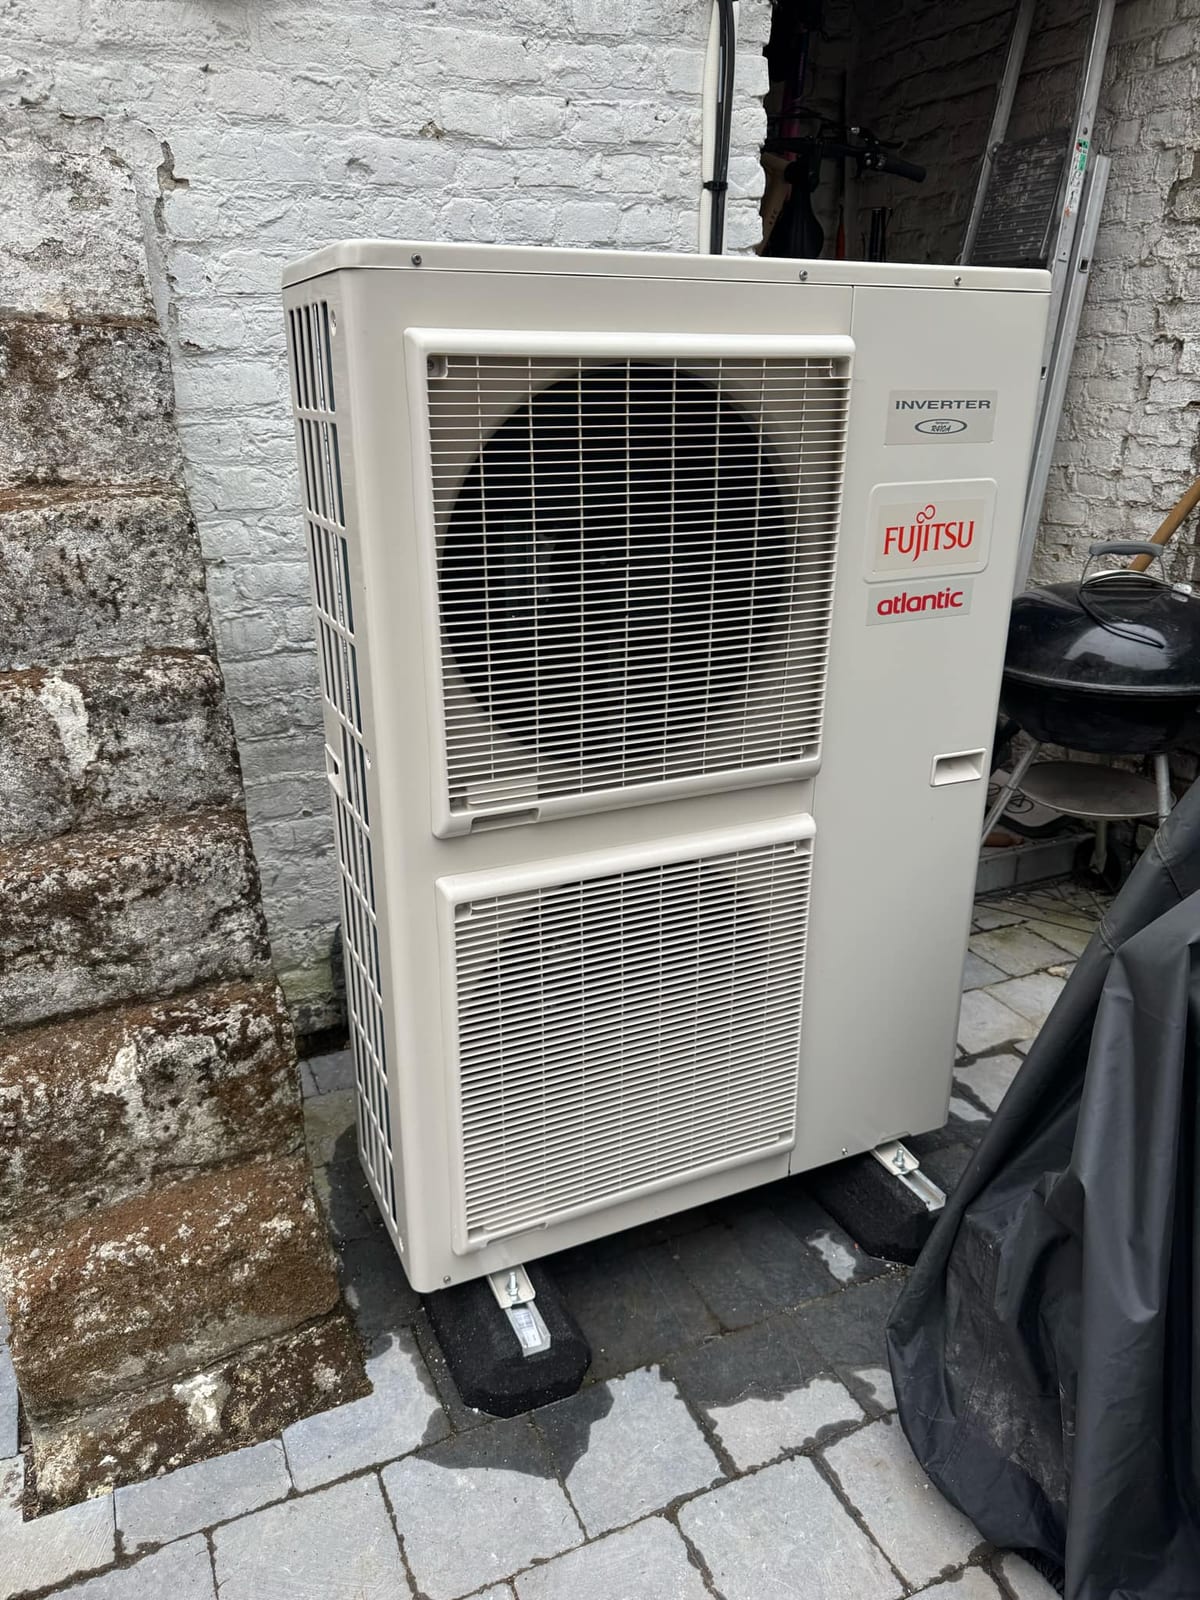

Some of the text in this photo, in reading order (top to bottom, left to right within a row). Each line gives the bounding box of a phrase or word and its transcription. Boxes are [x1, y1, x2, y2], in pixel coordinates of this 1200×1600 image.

[895, 400, 991, 410] INVERTER
[883, 520, 975, 562] FUJITSU
[877, 587, 964, 616] atlantic
